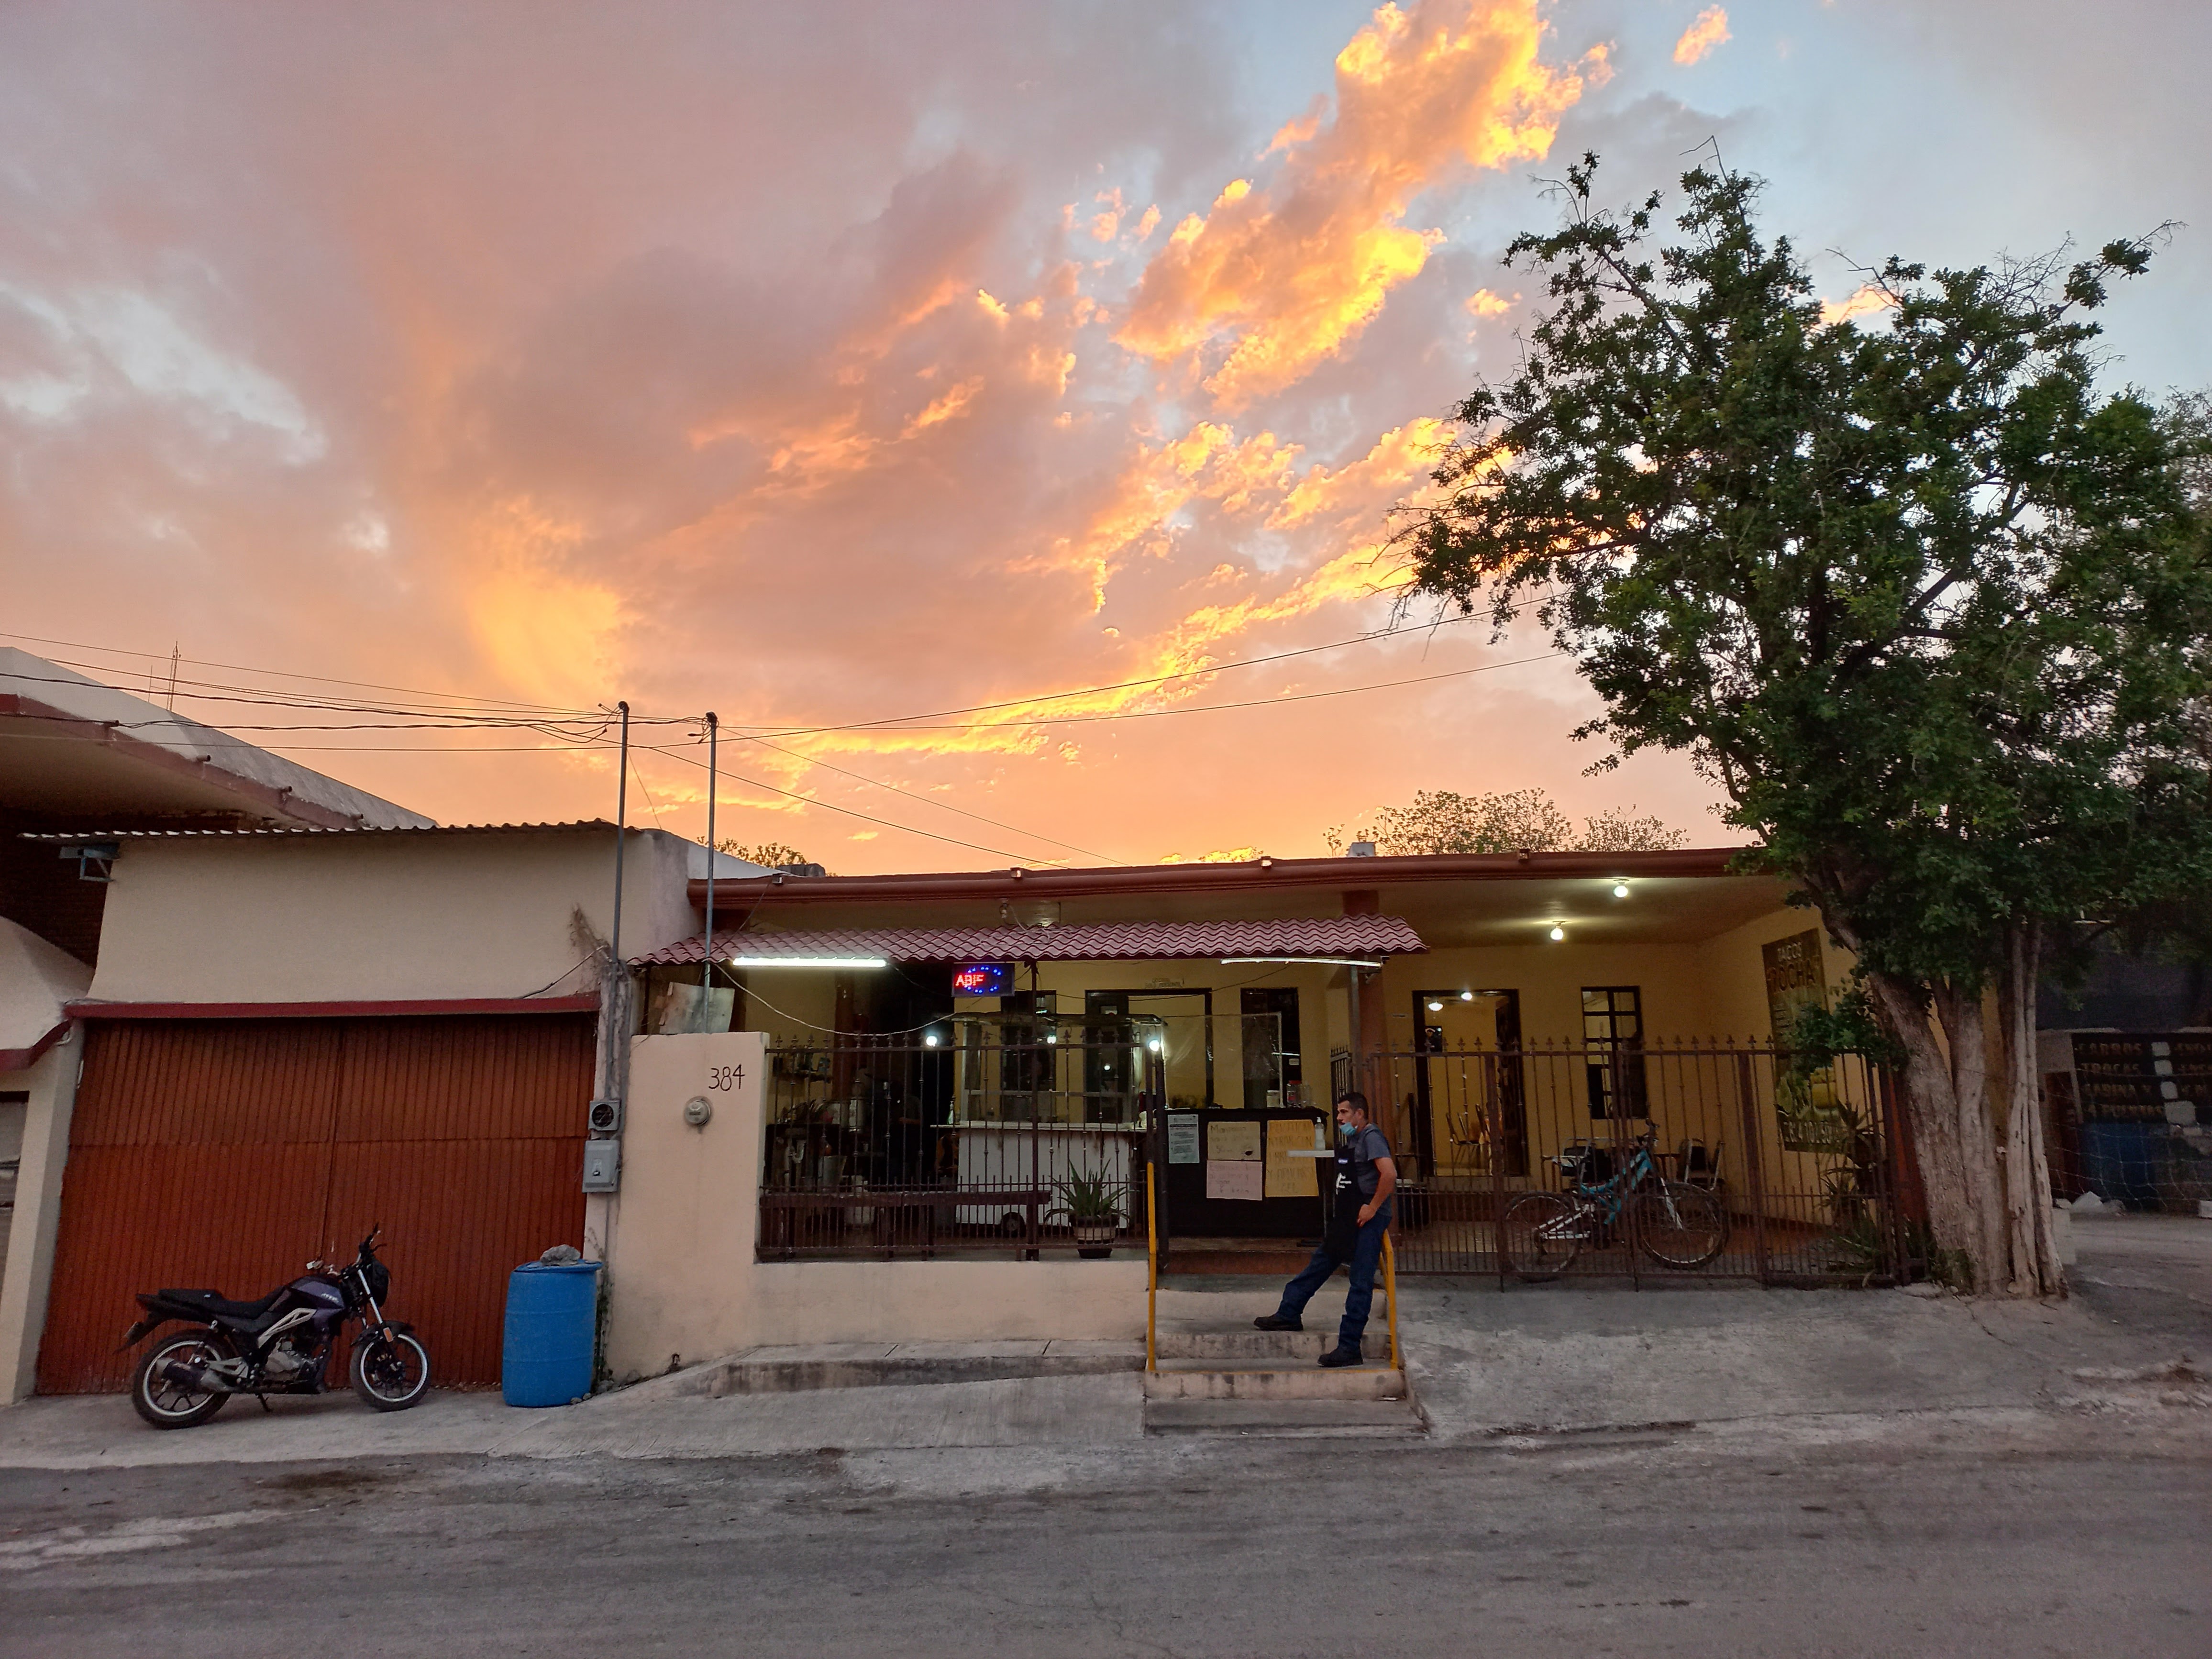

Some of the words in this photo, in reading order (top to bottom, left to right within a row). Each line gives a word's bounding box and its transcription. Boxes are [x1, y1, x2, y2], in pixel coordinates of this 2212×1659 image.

[1777, 941, 1802, 962] TACOS
[1767, 958, 1815, 992] ROCHA
[708, 1063, 745, 1091] 384
